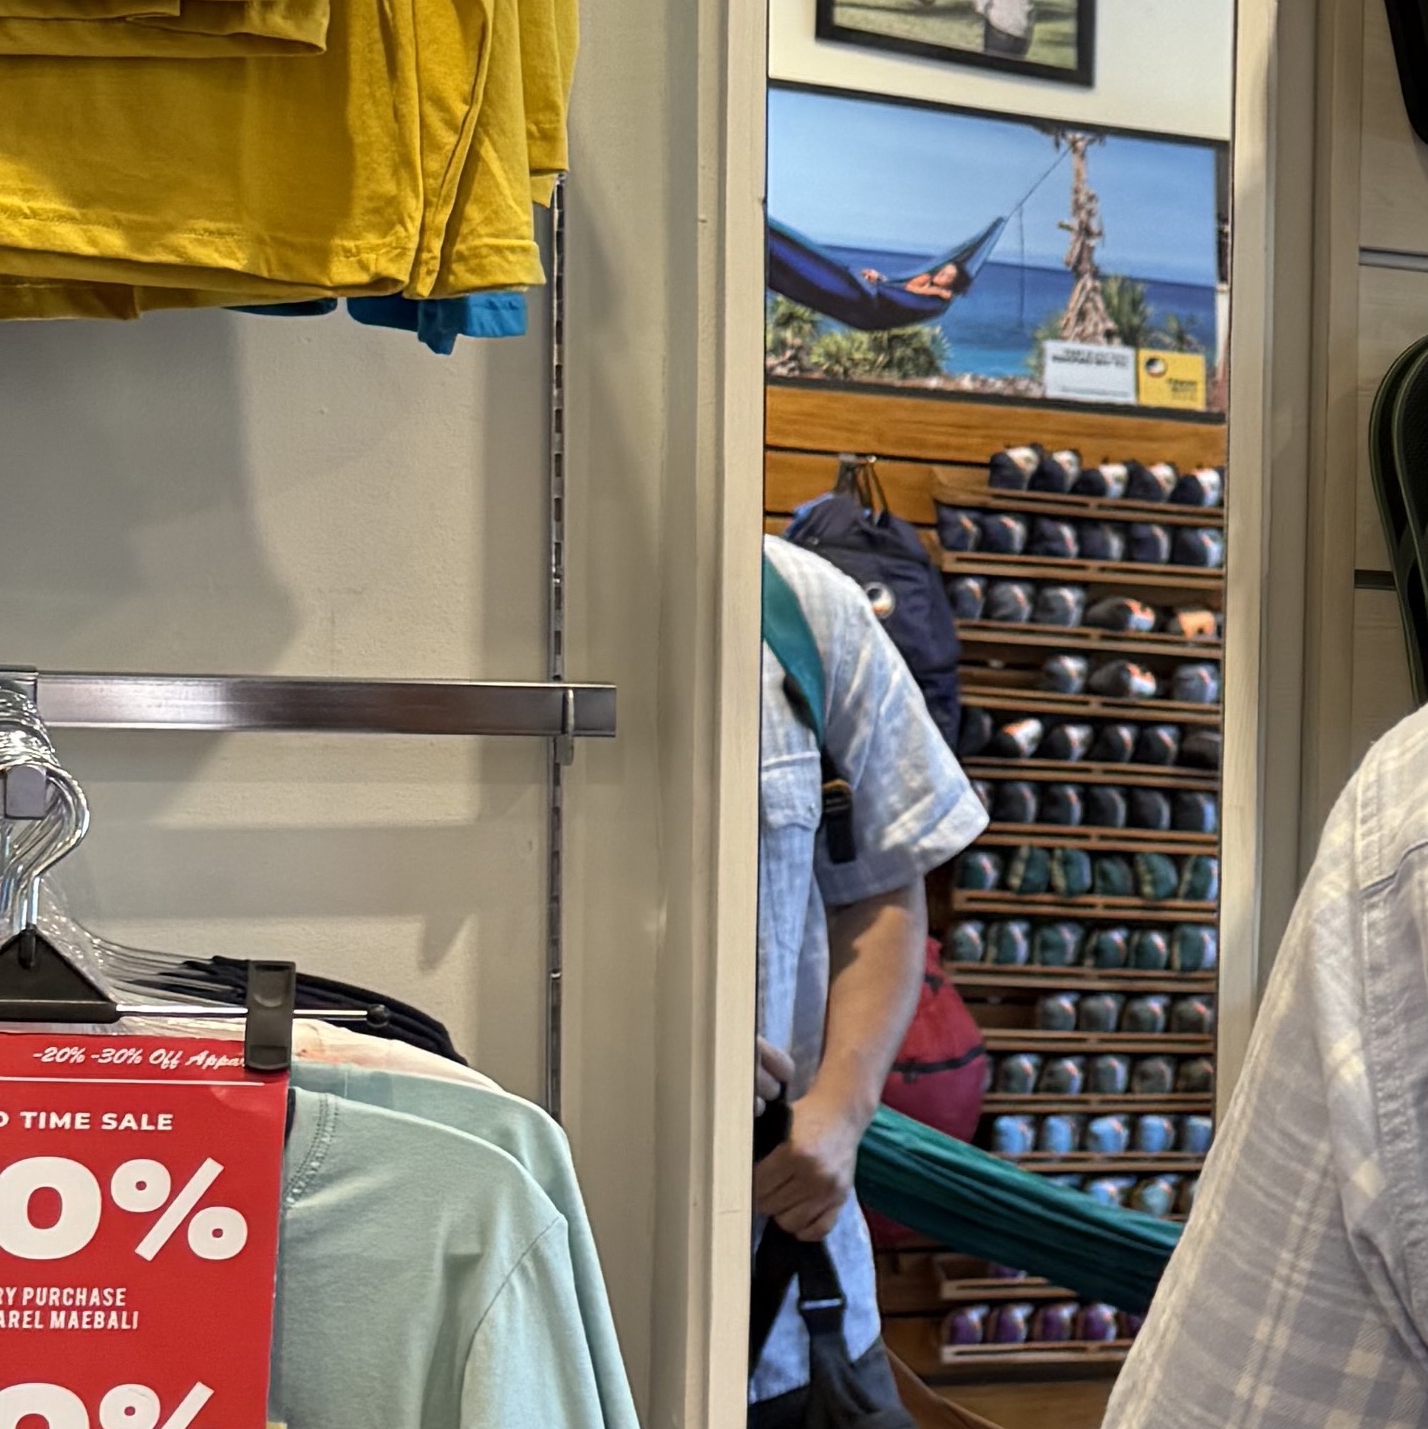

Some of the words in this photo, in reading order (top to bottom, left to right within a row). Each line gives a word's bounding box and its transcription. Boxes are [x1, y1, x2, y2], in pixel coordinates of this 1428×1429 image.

[32, 1046, 86, 1064] -20%
[90, 1047, 143, 1065] -30%
[148, 1047, 183, 1070] Off
[20, 1110, 91, 1130] TIME
[101, 1112, 174, 1131] SALE
[22, 1286, 127, 1307] PURCHASE
[50, 1309, 140, 1330] MAEBALI
